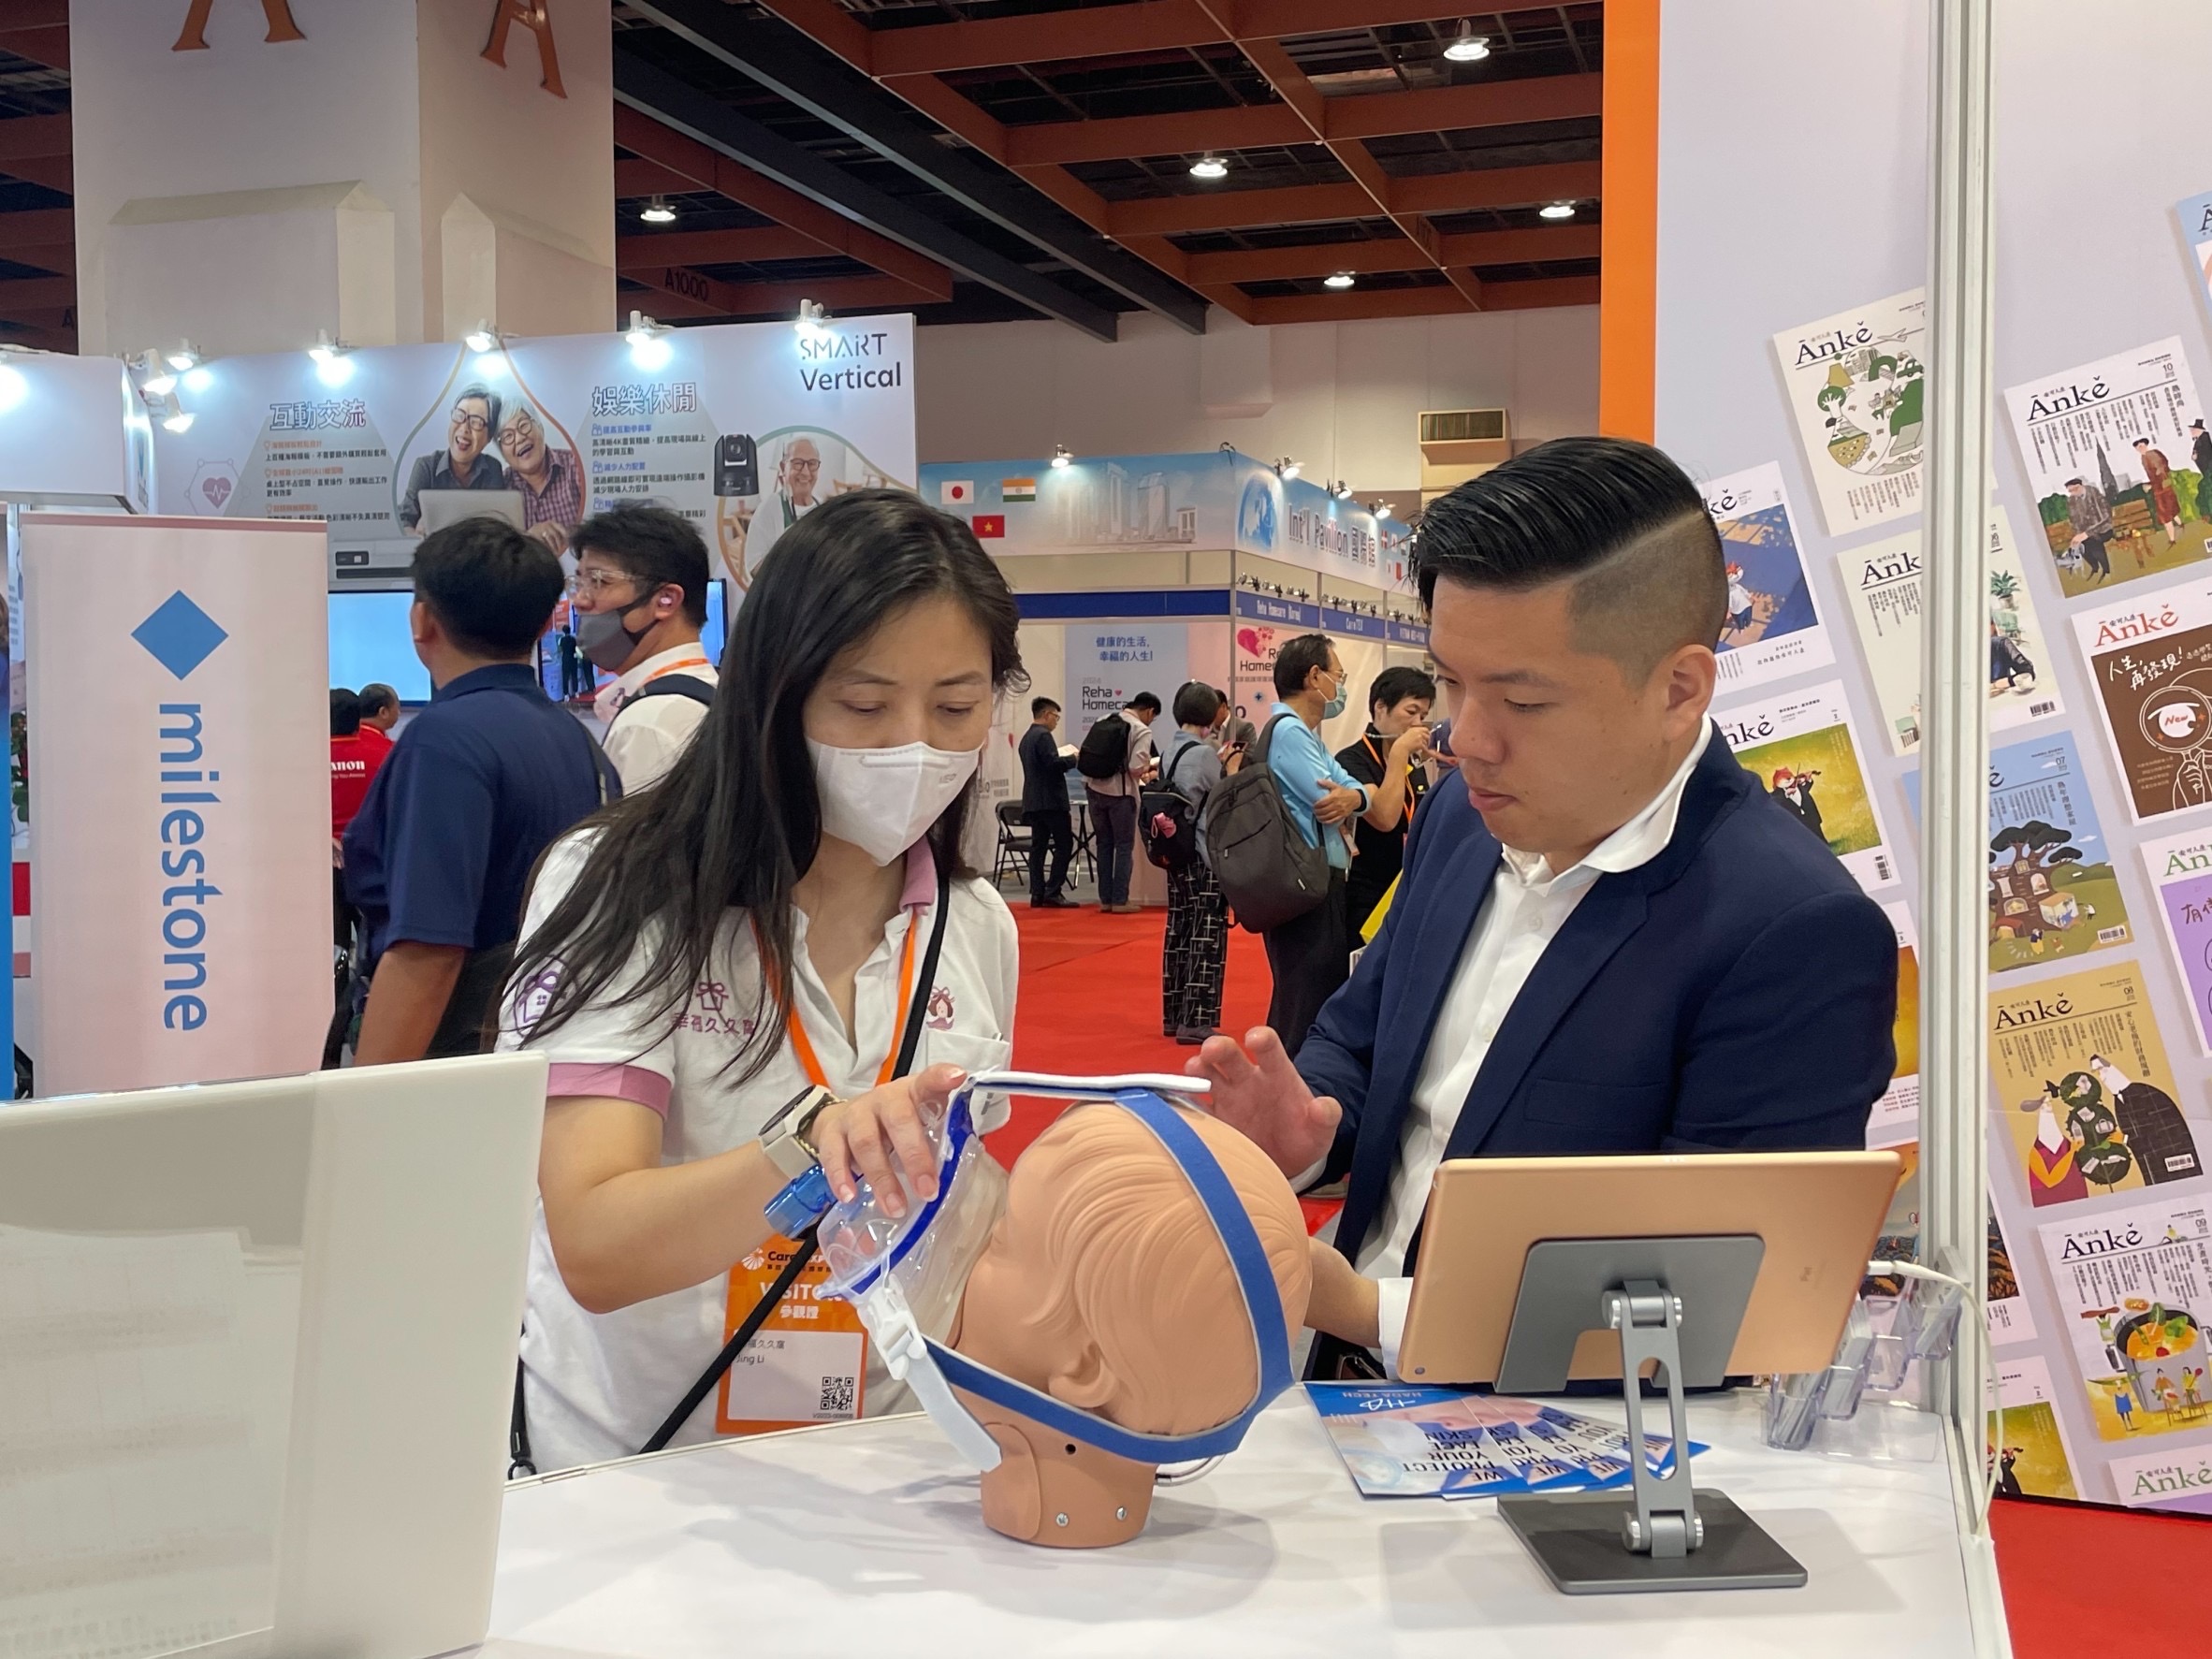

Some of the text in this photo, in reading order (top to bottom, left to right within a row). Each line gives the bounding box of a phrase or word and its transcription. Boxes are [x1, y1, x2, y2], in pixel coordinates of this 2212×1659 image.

[2162, 362, 2173, 373] 10
[800, 361, 902, 391] Vertical
[591, 382, 697, 416] 娛樂休閒
[269, 399, 367, 431] 互動交流
[1314, 513, 1349, 555] Pavilion
[1860, 552, 1922, 587] Ānk
[1082, 686, 1113, 698] Reha
[1082, 698, 1127, 710] Homeca
[2164, 715, 2190, 727] New
[330, 761, 366, 771] anon
[159, 703, 223, 1031] milestone
[1424, 1430, 1473, 1441] SKIN
[1427, 1442, 1480, 1450] FACE
[1430, 1450, 1489, 1462] YOUR
[1403, 1462, 1496, 1473] PROTECT
